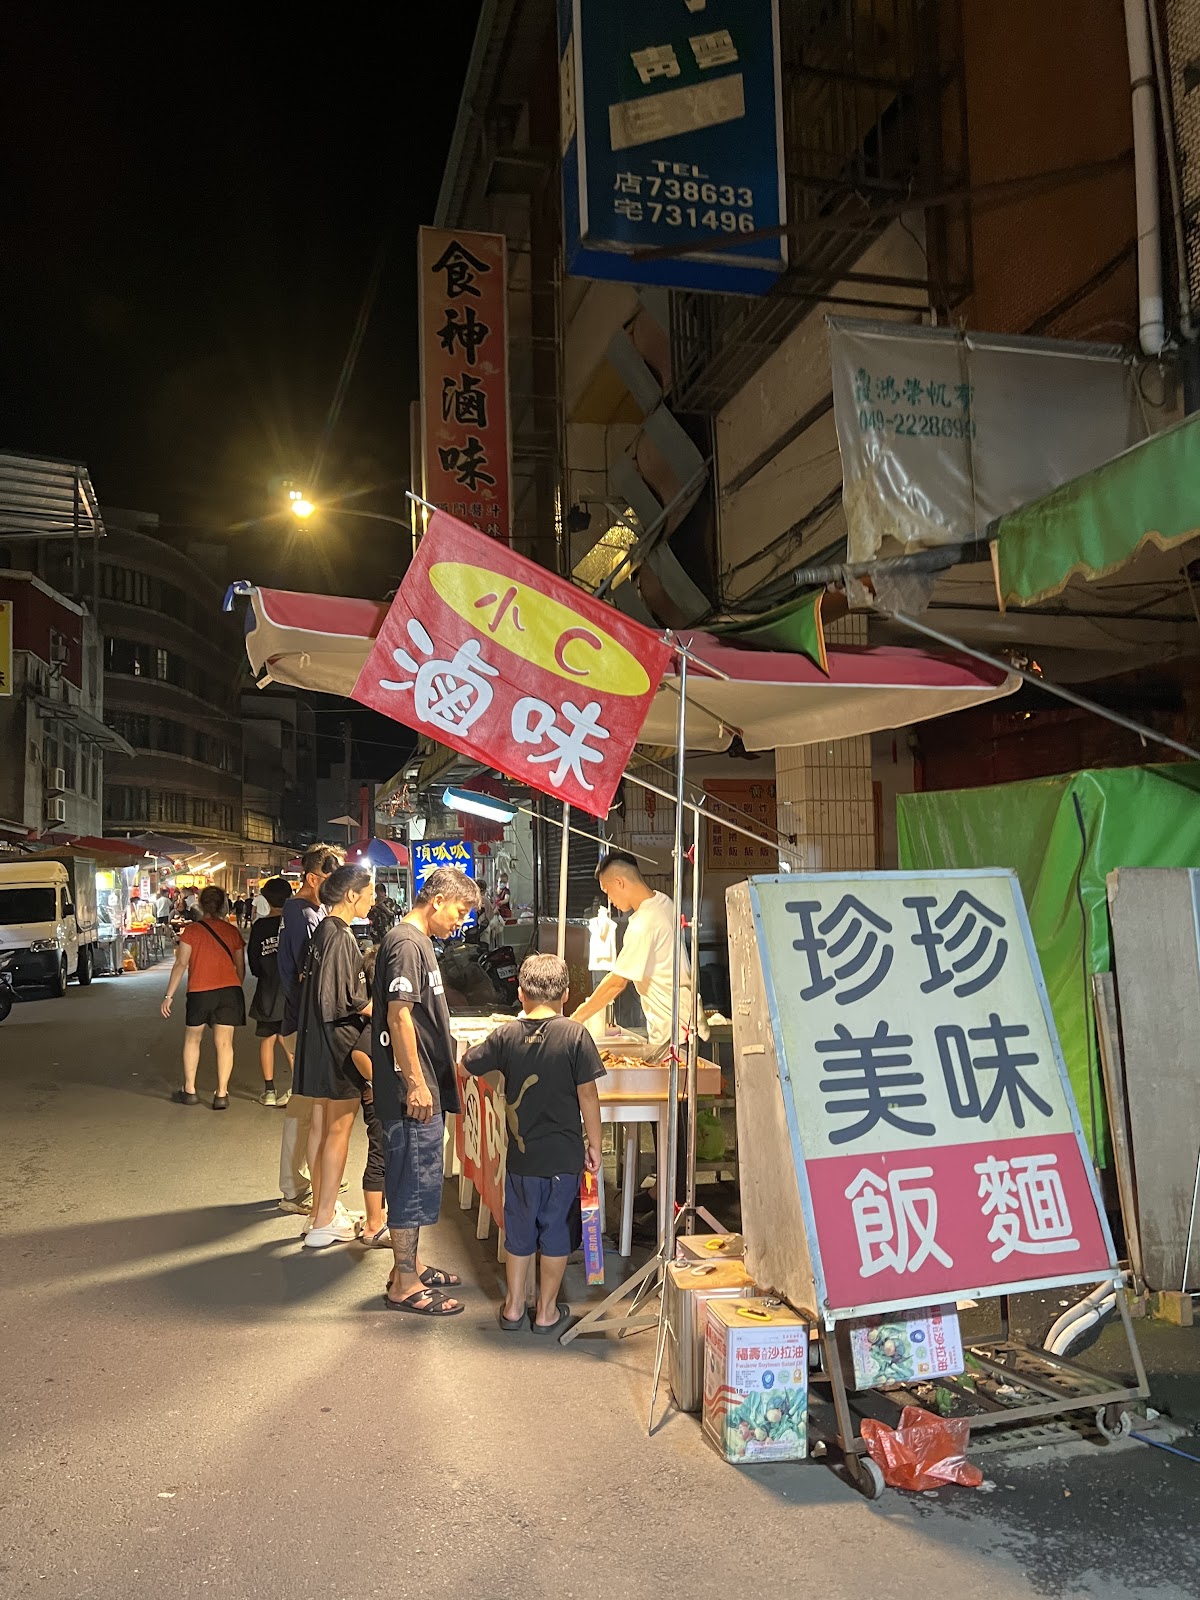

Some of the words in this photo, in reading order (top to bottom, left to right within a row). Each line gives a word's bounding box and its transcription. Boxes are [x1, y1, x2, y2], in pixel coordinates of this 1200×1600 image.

[613, 171, 754, 208] 店738633
[613, 198, 756, 234] 宅731496
[651, 159, 709, 179] TEL
[431, 239, 496, 492] 食神滷味
[379, 617, 611, 791] 滷味
[415, 840, 471, 863] 頂呱呱
[784, 889, 1010, 1006] 珍珍
[814, 1012, 1055, 1146] 美味
[844, 1152, 1081, 1279] 飯麵
